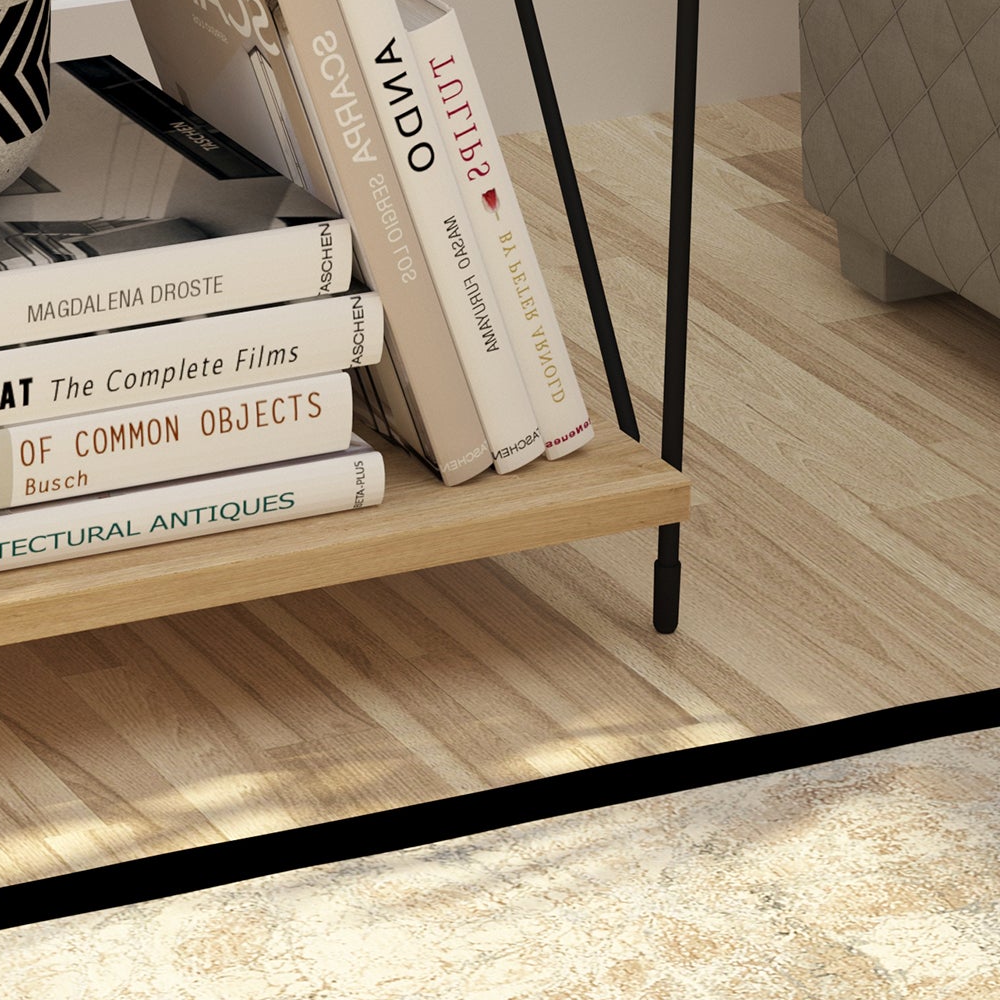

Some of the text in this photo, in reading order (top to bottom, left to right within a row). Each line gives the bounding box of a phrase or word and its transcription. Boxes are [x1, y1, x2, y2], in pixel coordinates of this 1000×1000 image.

[26, 282, 146, 324] MAGDALENA
[151, 274, 225, 304] DROSTE
[51, 376, 96, 403] The
[105, 354, 226, 397] Complete
[234, 341, 301, 374] Films
[19, 434, 54, 467] OF
[74, 414, 181, 458] COMMON
[200, 391, 324, 438] OBJECTS
[24, 469, 90, 498] Busch
[149, 490, 296, 534] ANTIQUES
